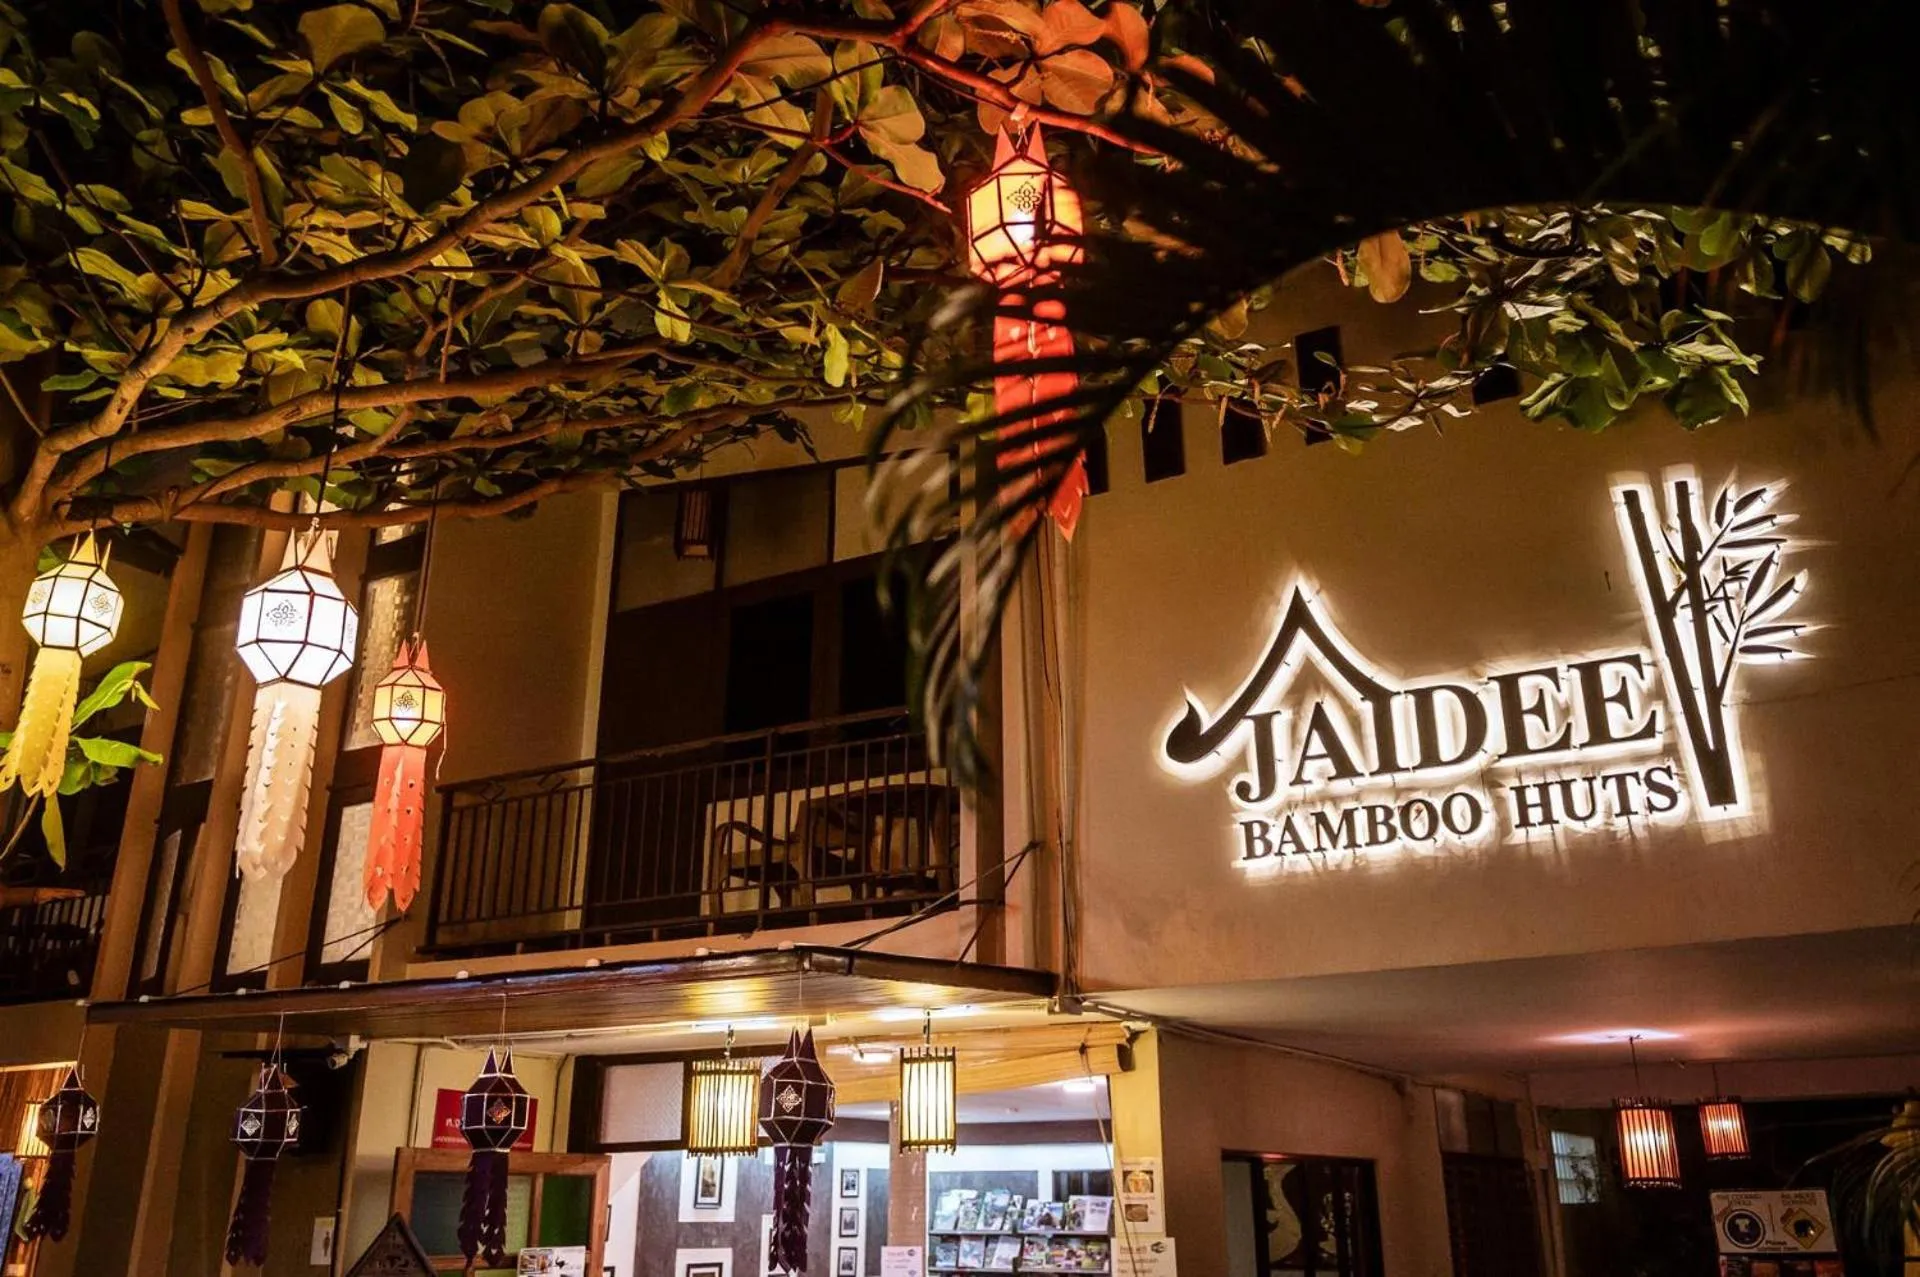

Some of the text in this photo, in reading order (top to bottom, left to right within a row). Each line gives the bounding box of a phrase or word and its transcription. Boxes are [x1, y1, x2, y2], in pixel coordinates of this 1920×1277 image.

[1234, 654, 1660, 802] JAIDEE
[1241, 765, 1680, 861] BAMBOO HUTS
